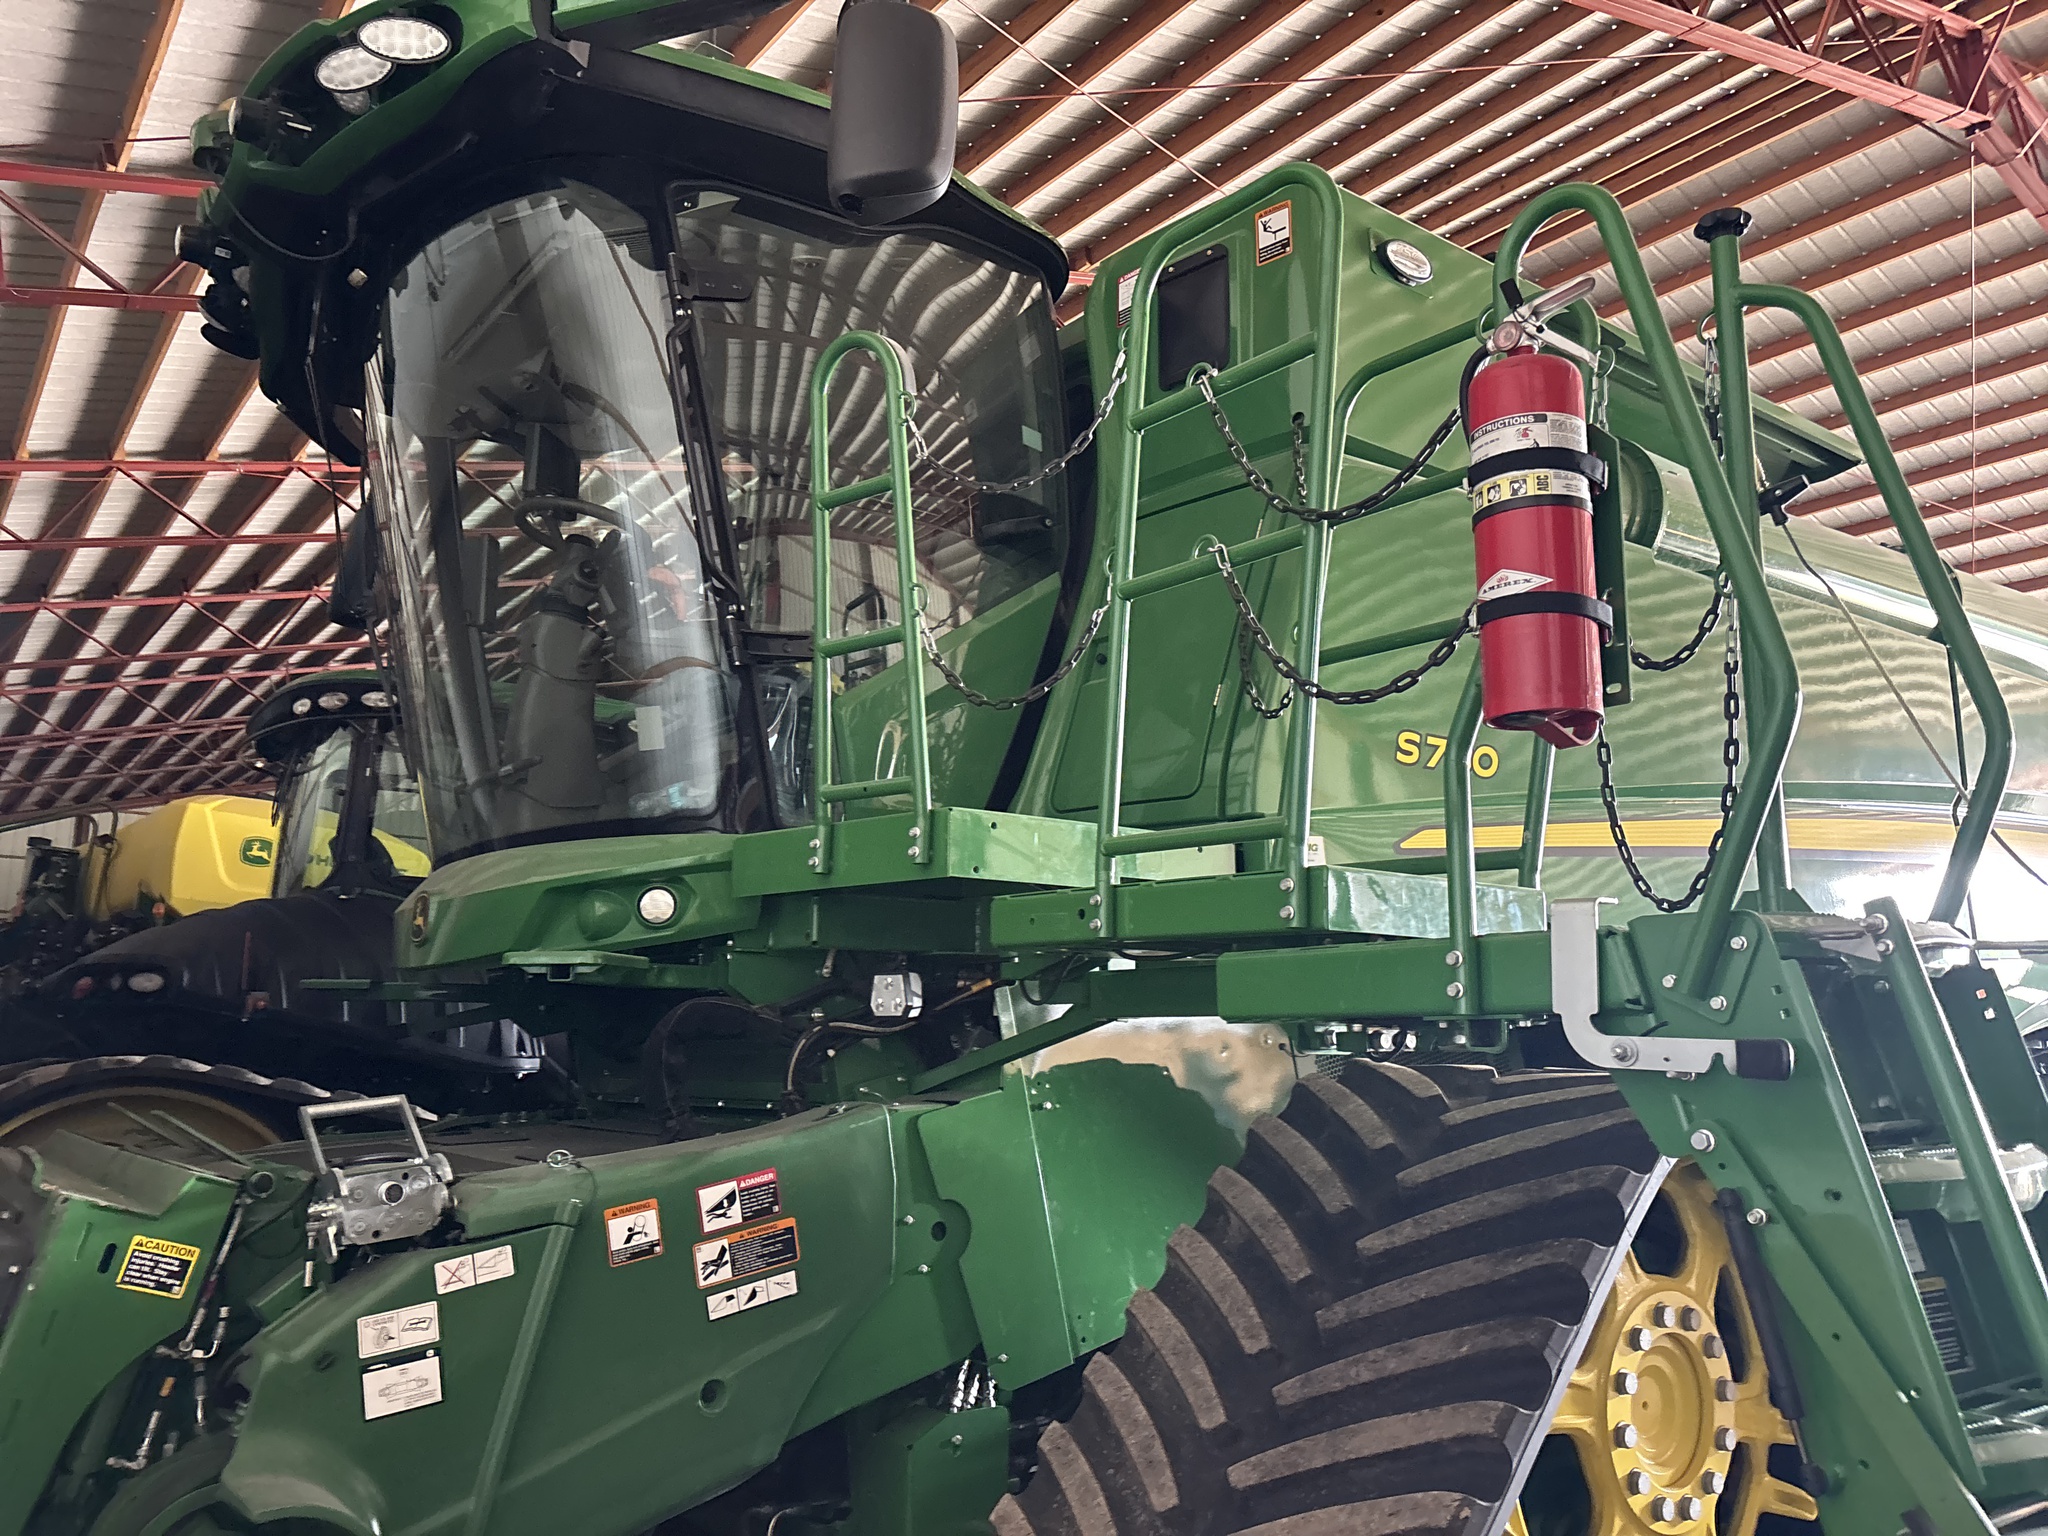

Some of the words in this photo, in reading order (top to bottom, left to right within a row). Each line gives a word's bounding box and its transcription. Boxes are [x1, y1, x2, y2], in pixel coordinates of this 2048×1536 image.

[1473, 415, 1535, 441] INSTRUCTIONS
[1536, 474, 1549, 491] ABC
[1482, 578, 1534, 594] AMEREX
[1395, 729, 1499, 778] S70
[745, 1172, 774, 1186] DANGER
[618, 1201, 651, 1214] WARNING
[746, 1223, 778, 1237] WARNING
[133, 1251, 153, 1259] Avoid
[145, 1240, 196, 1258] CAUTION
